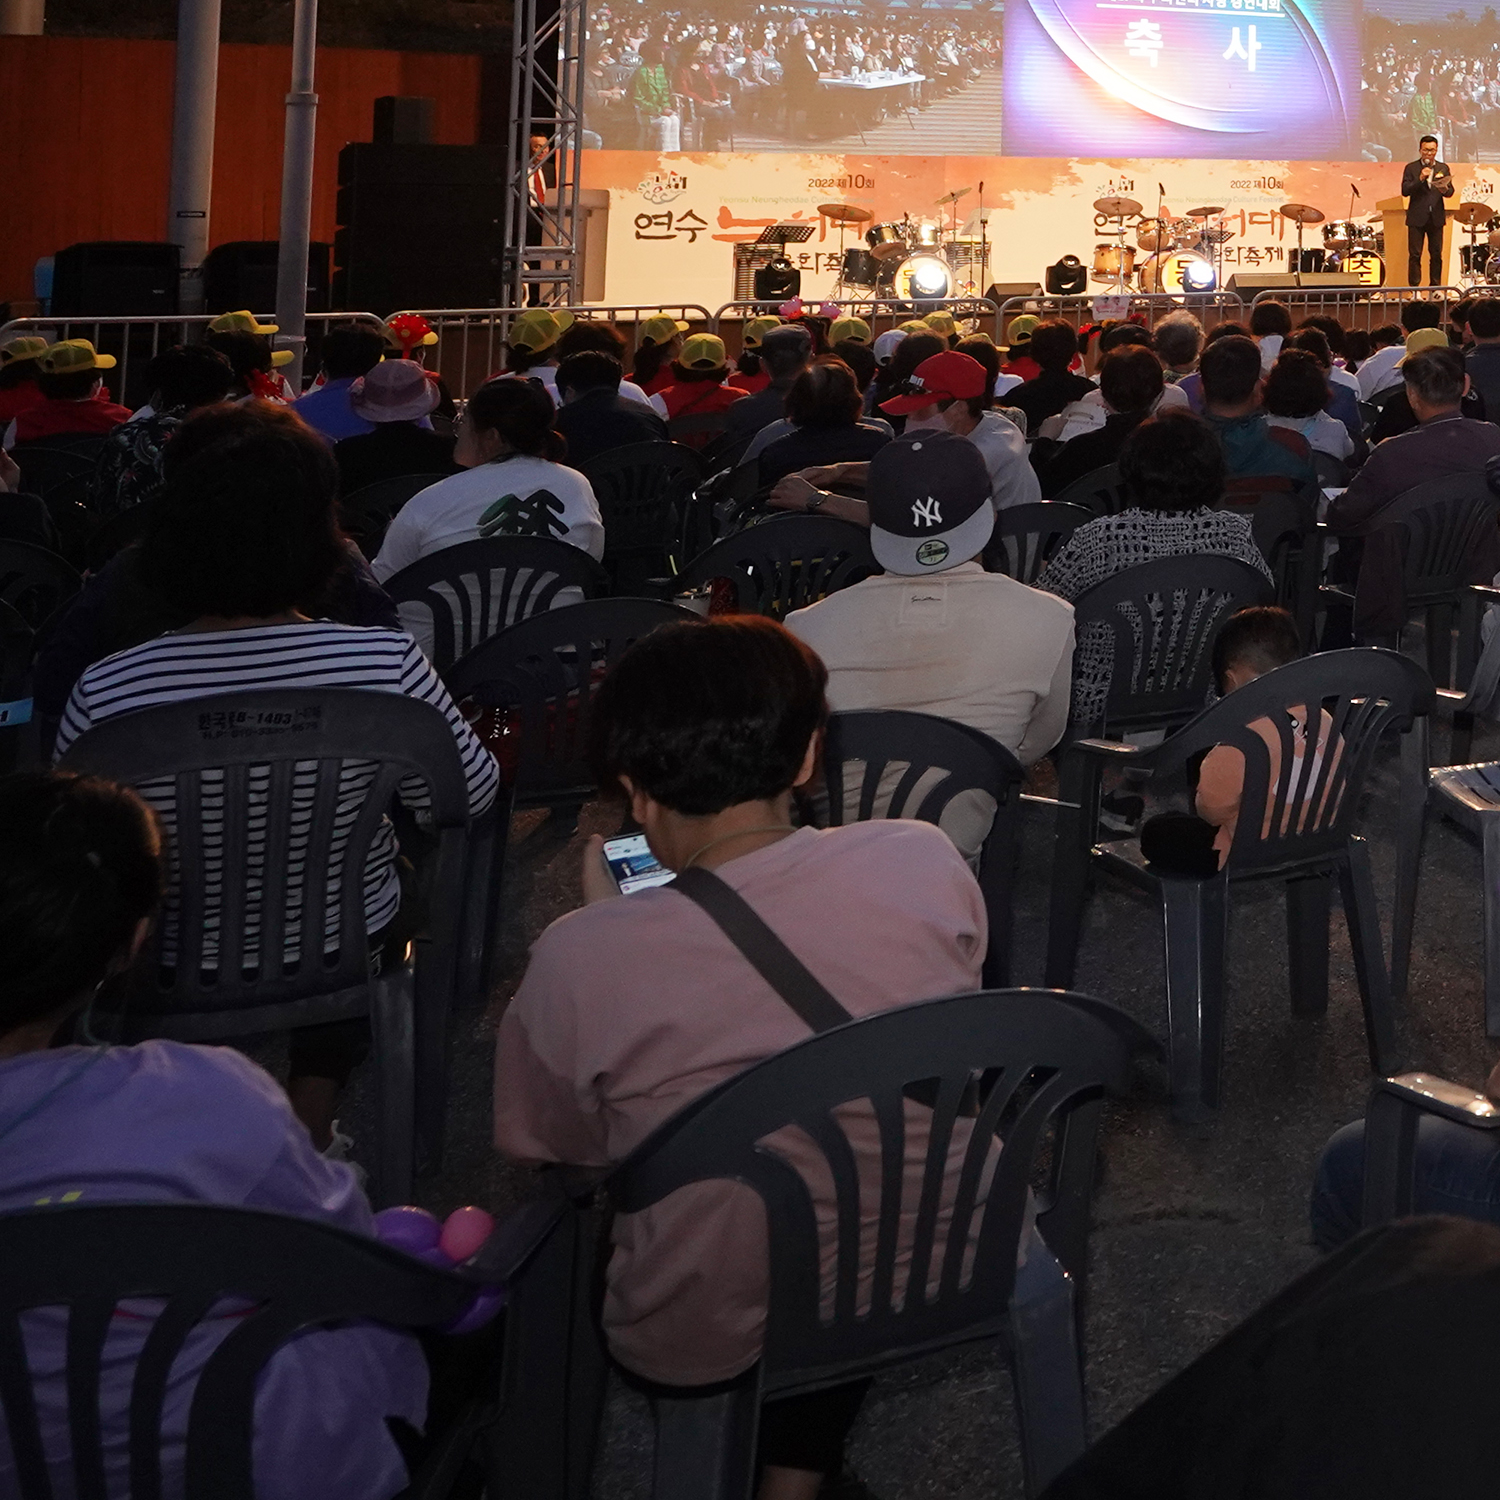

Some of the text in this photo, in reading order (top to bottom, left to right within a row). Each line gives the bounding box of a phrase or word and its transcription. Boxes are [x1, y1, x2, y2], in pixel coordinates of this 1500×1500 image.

[1124, 18, 1262, 72] 축 사
[808, 174, 875, 189] 2022 제10회
[1230, 176, 1284, 190] 2022 제10회
[718, 195, 750, 204] Yeonsu
[751, 195, 809, 205] Neungheodae
[1259, 196, 1285, 204] Festival
[634, 209, 708, 243] 연수
[911, 496, 943, 528] NY
